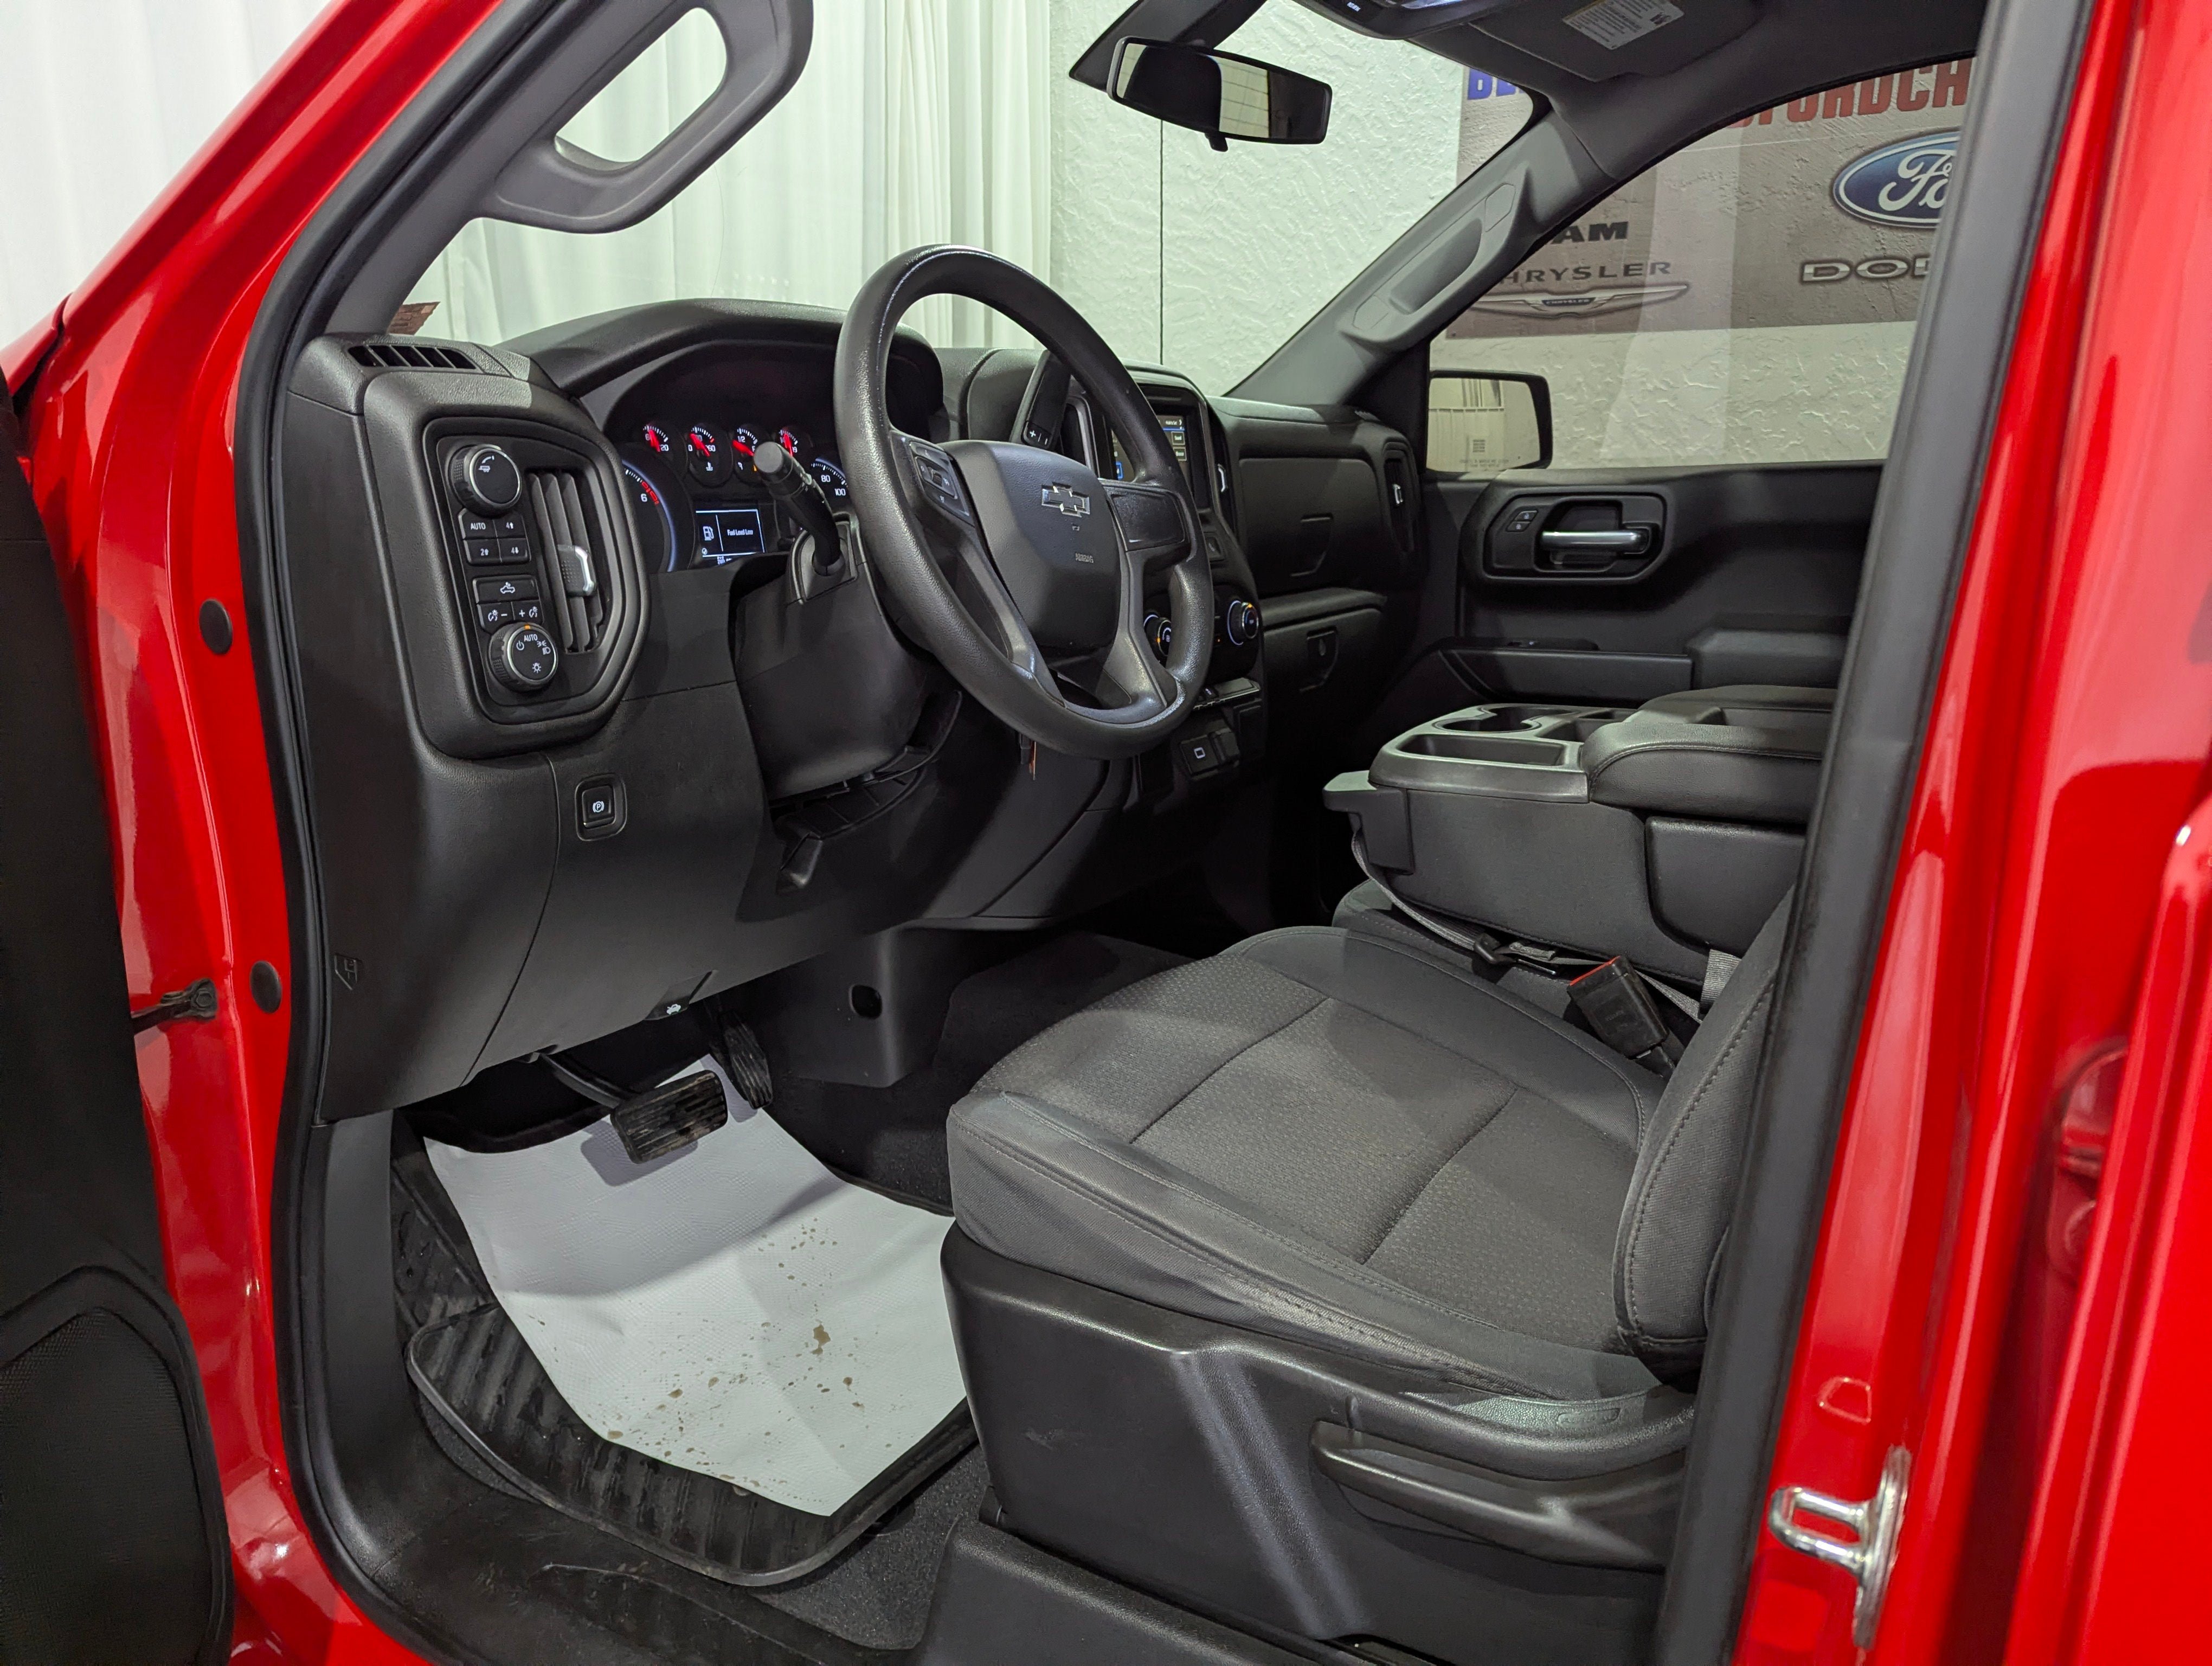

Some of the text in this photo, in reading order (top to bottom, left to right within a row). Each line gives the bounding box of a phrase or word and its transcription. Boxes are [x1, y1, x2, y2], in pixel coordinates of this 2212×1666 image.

[821, 475, 831, 483] 80
[835, 488, 846, 496] 100
[640, 493, 648, 502] 6
[1075, 553, 1094, 563] AIRBAG
[524, 633, 538, 642] AUTO
